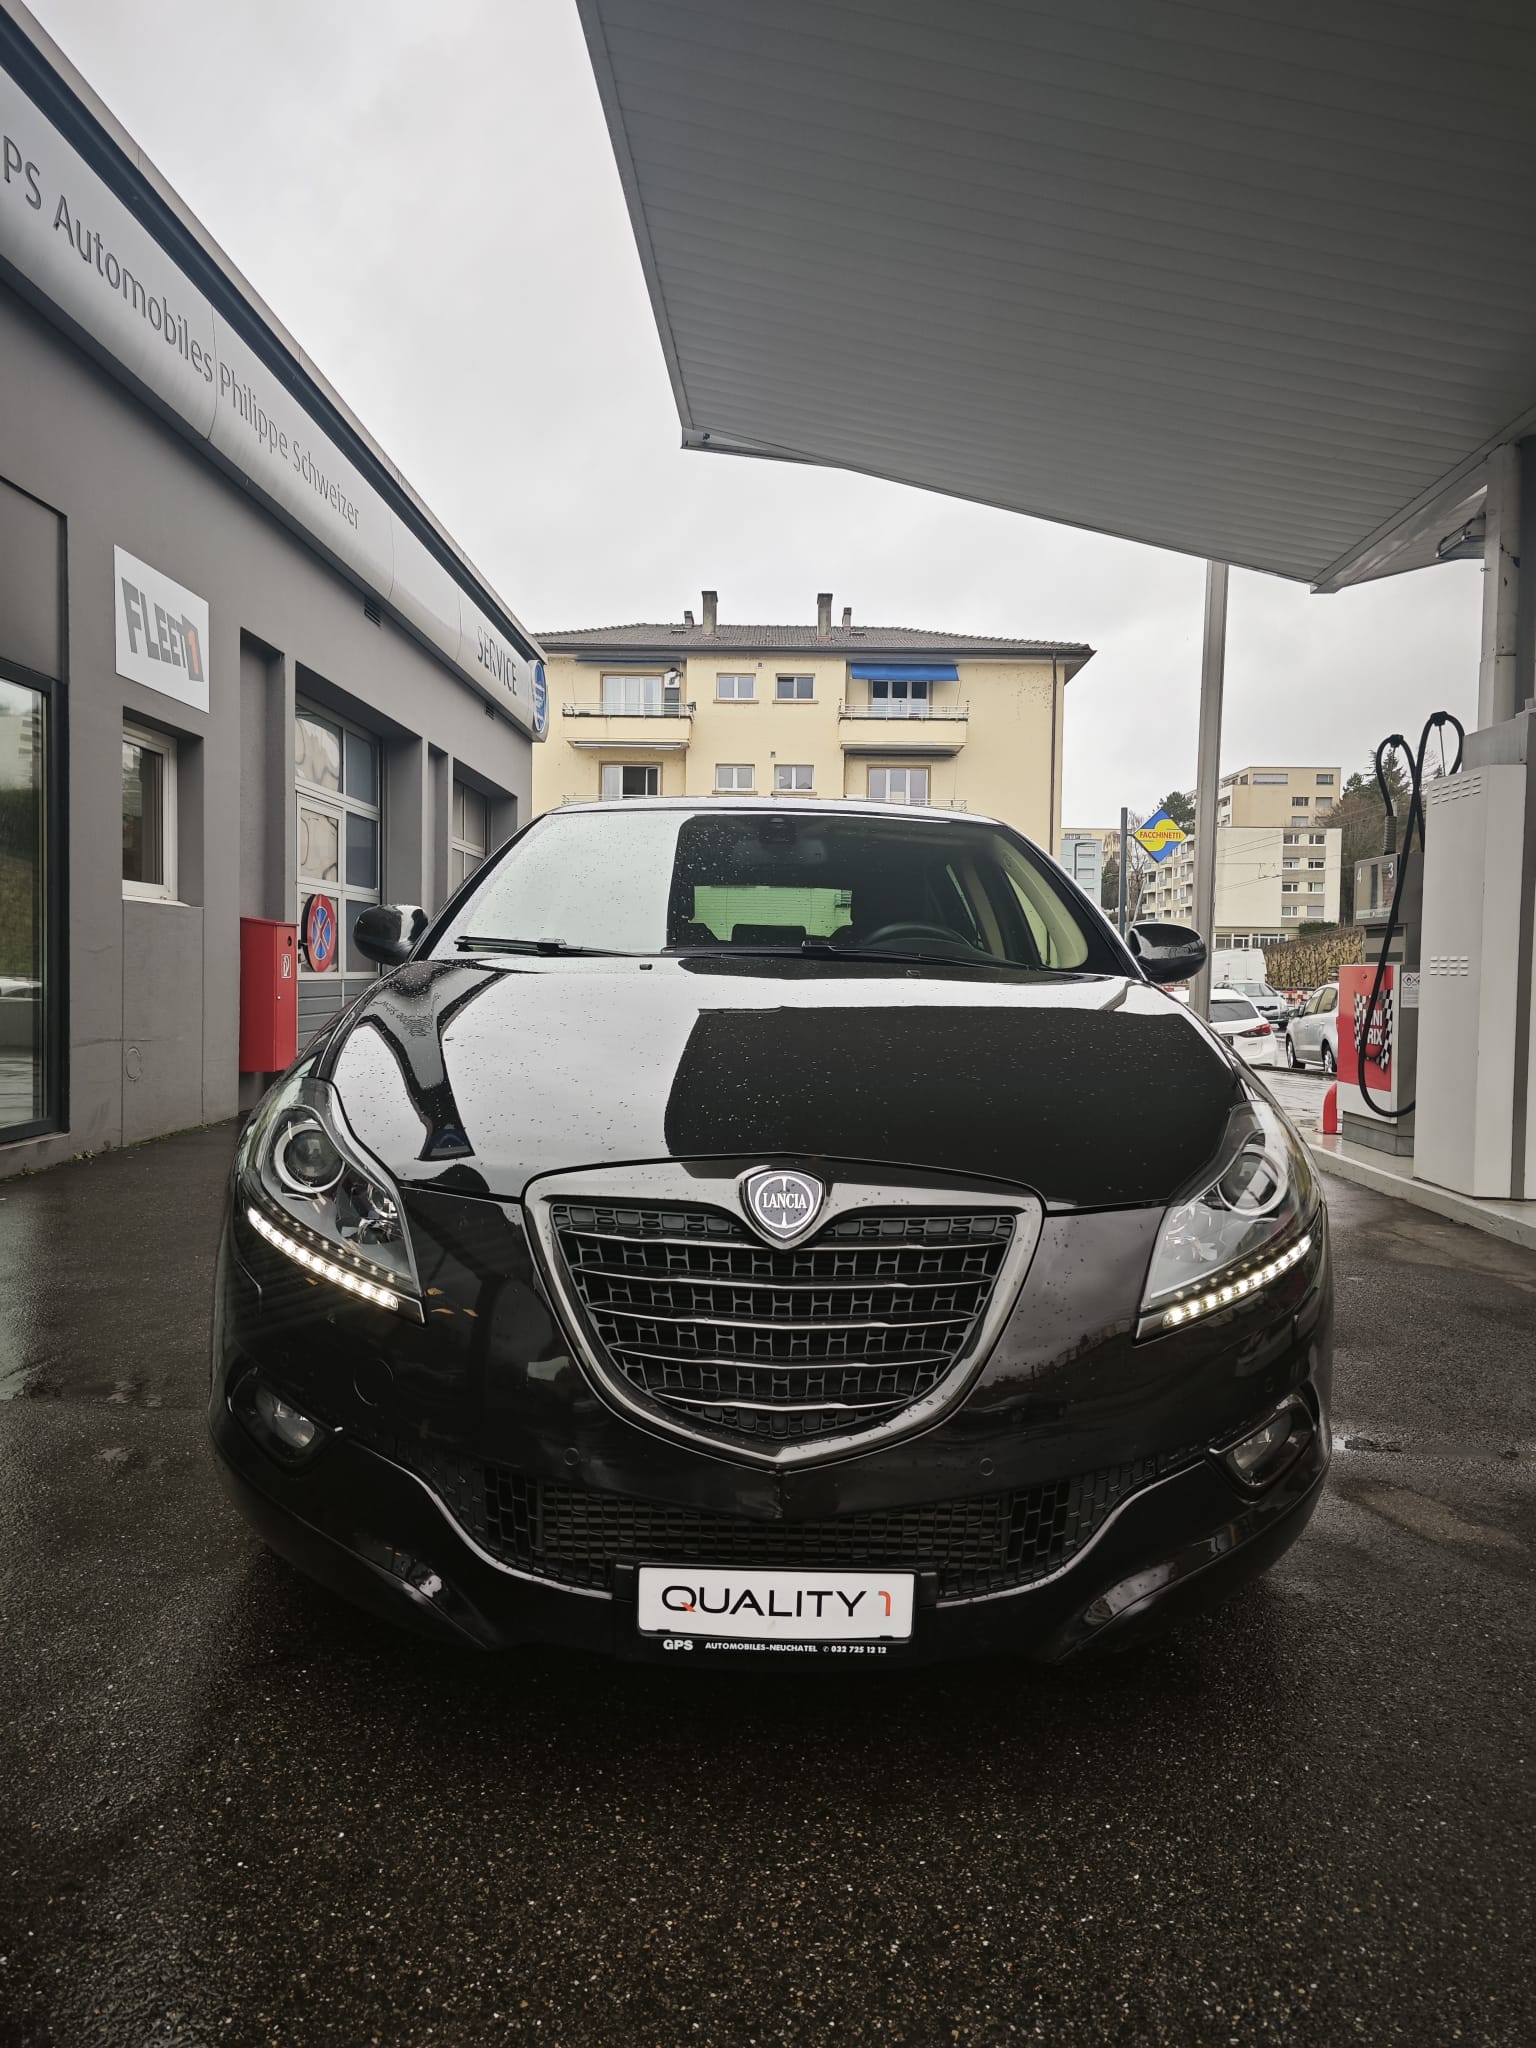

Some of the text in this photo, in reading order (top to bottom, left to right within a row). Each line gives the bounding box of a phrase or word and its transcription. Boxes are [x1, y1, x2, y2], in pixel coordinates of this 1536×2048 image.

[53, 194, 213, 382] Automobiles
[219, 361, 288, 459] Philippe
[293, 440, 360, 530] Schweizer
[477, 625, 517, 697] SERVICE
[1139, 831, 1181, 839] FACCHINETTI
[763, 1192, 807, 1209] LANCIA
[661, 1585, 891, 1617] QUALITY 1
[662, 1639, 694, 1651] GPS
[704, 1641, 818, 1653] AUTOMOBILES-NEUCHATEL
[831, 1645, 847, 1653] 032
[849, 1645, 865, 1653] 725
